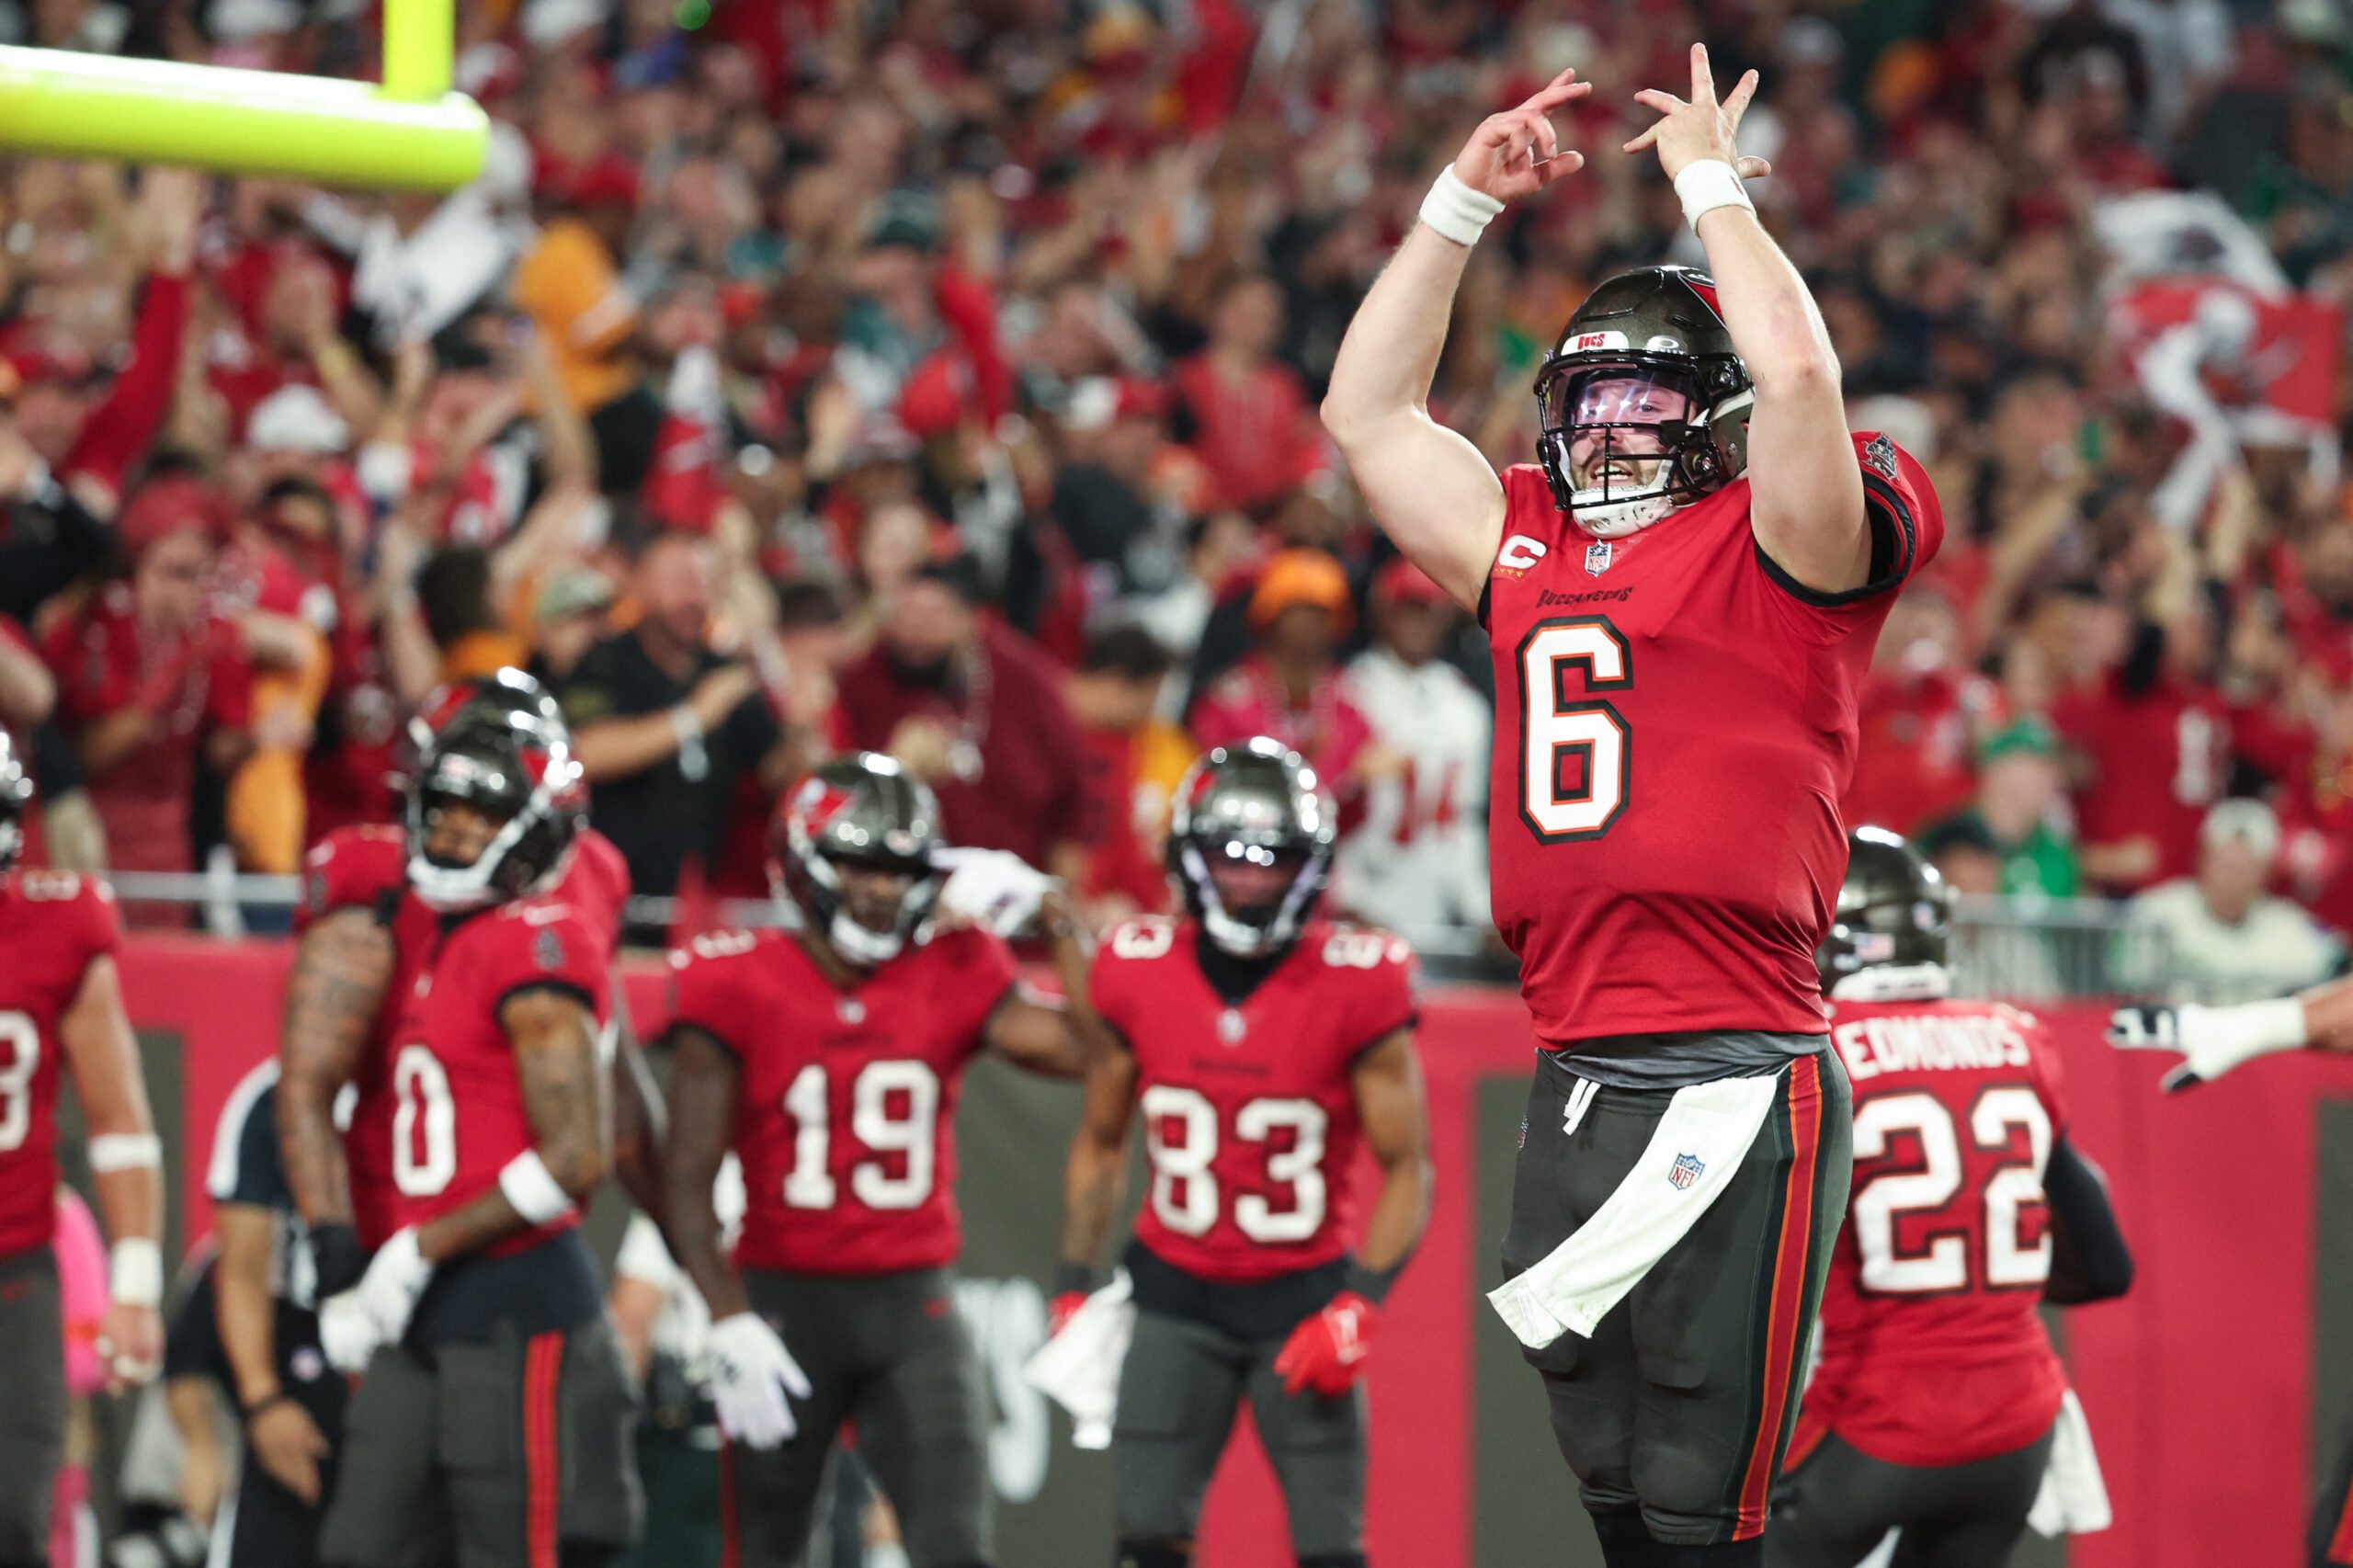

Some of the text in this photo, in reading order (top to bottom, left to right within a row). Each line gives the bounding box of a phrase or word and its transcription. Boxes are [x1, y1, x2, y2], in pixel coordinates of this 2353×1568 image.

[1498, 534, 1547, 569] C
[1518, 615, 1632, 843] 6
[393, 1045, 456, 1195] 0
[1834, 1015, 2030, 1081] EDMONDS
[784, 1059, 939, 1210] 19
[1142, 1085, 1326, 1242] 83
[1671, 1165, 1696, 1187] NFL
[1852, 1090, 2053, 1292] 22
